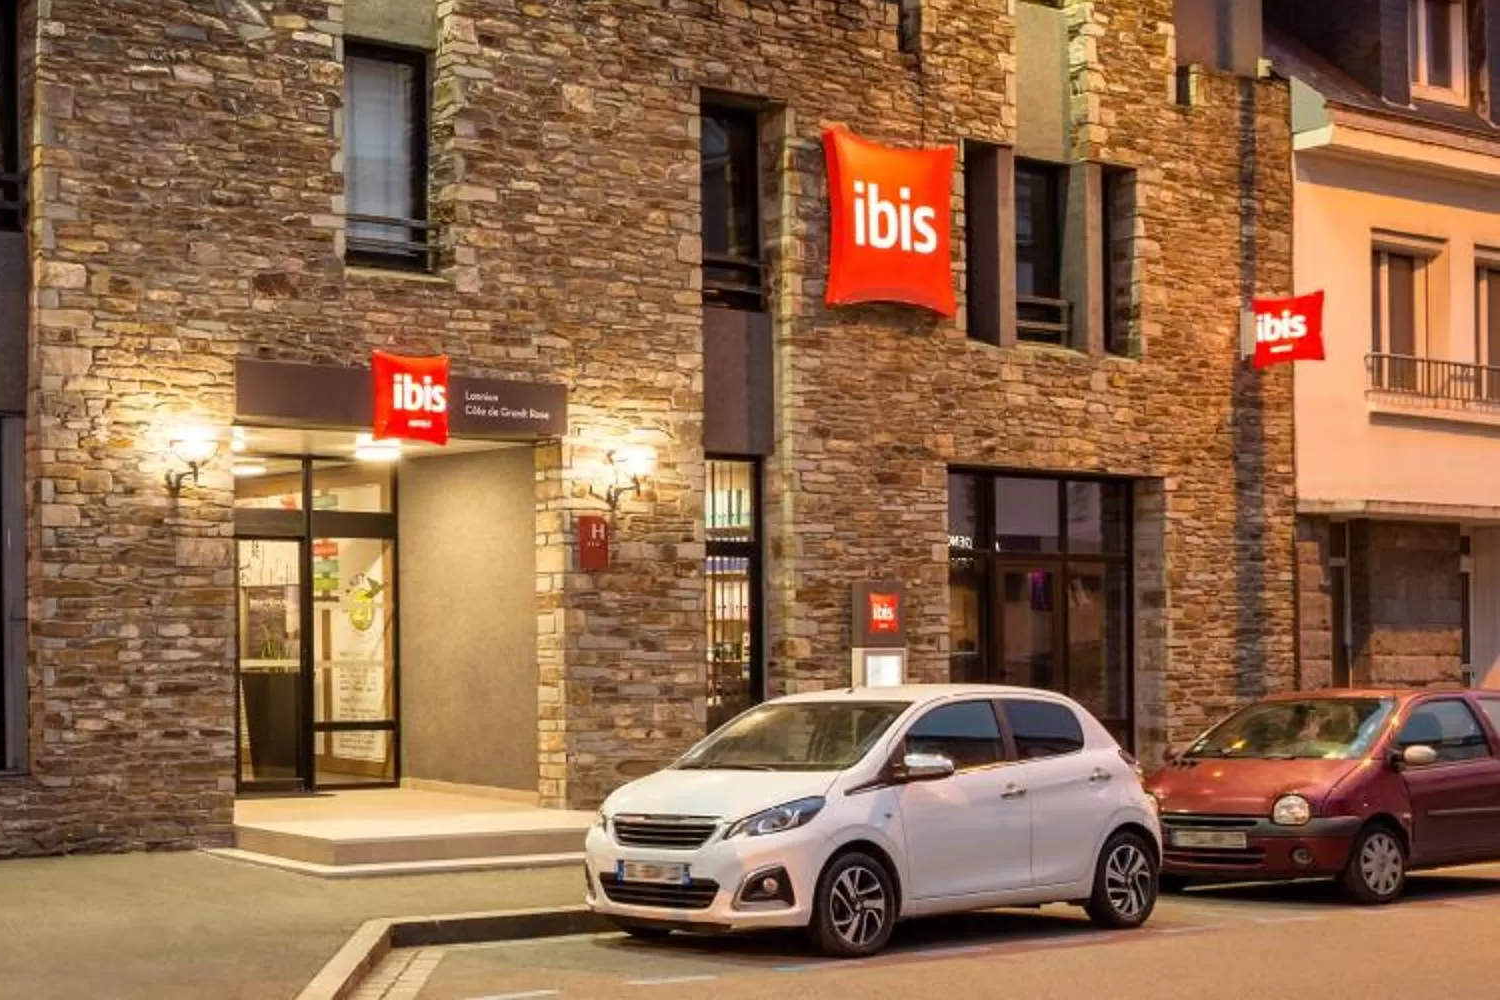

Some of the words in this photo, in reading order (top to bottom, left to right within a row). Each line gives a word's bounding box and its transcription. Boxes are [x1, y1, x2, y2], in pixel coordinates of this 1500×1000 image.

[853, 180, 938, 254] ibis
[1256, 309, 1307, 342] ibis
[393, 373, 447, 413] ibis
[591, 523, 605, 539] H
